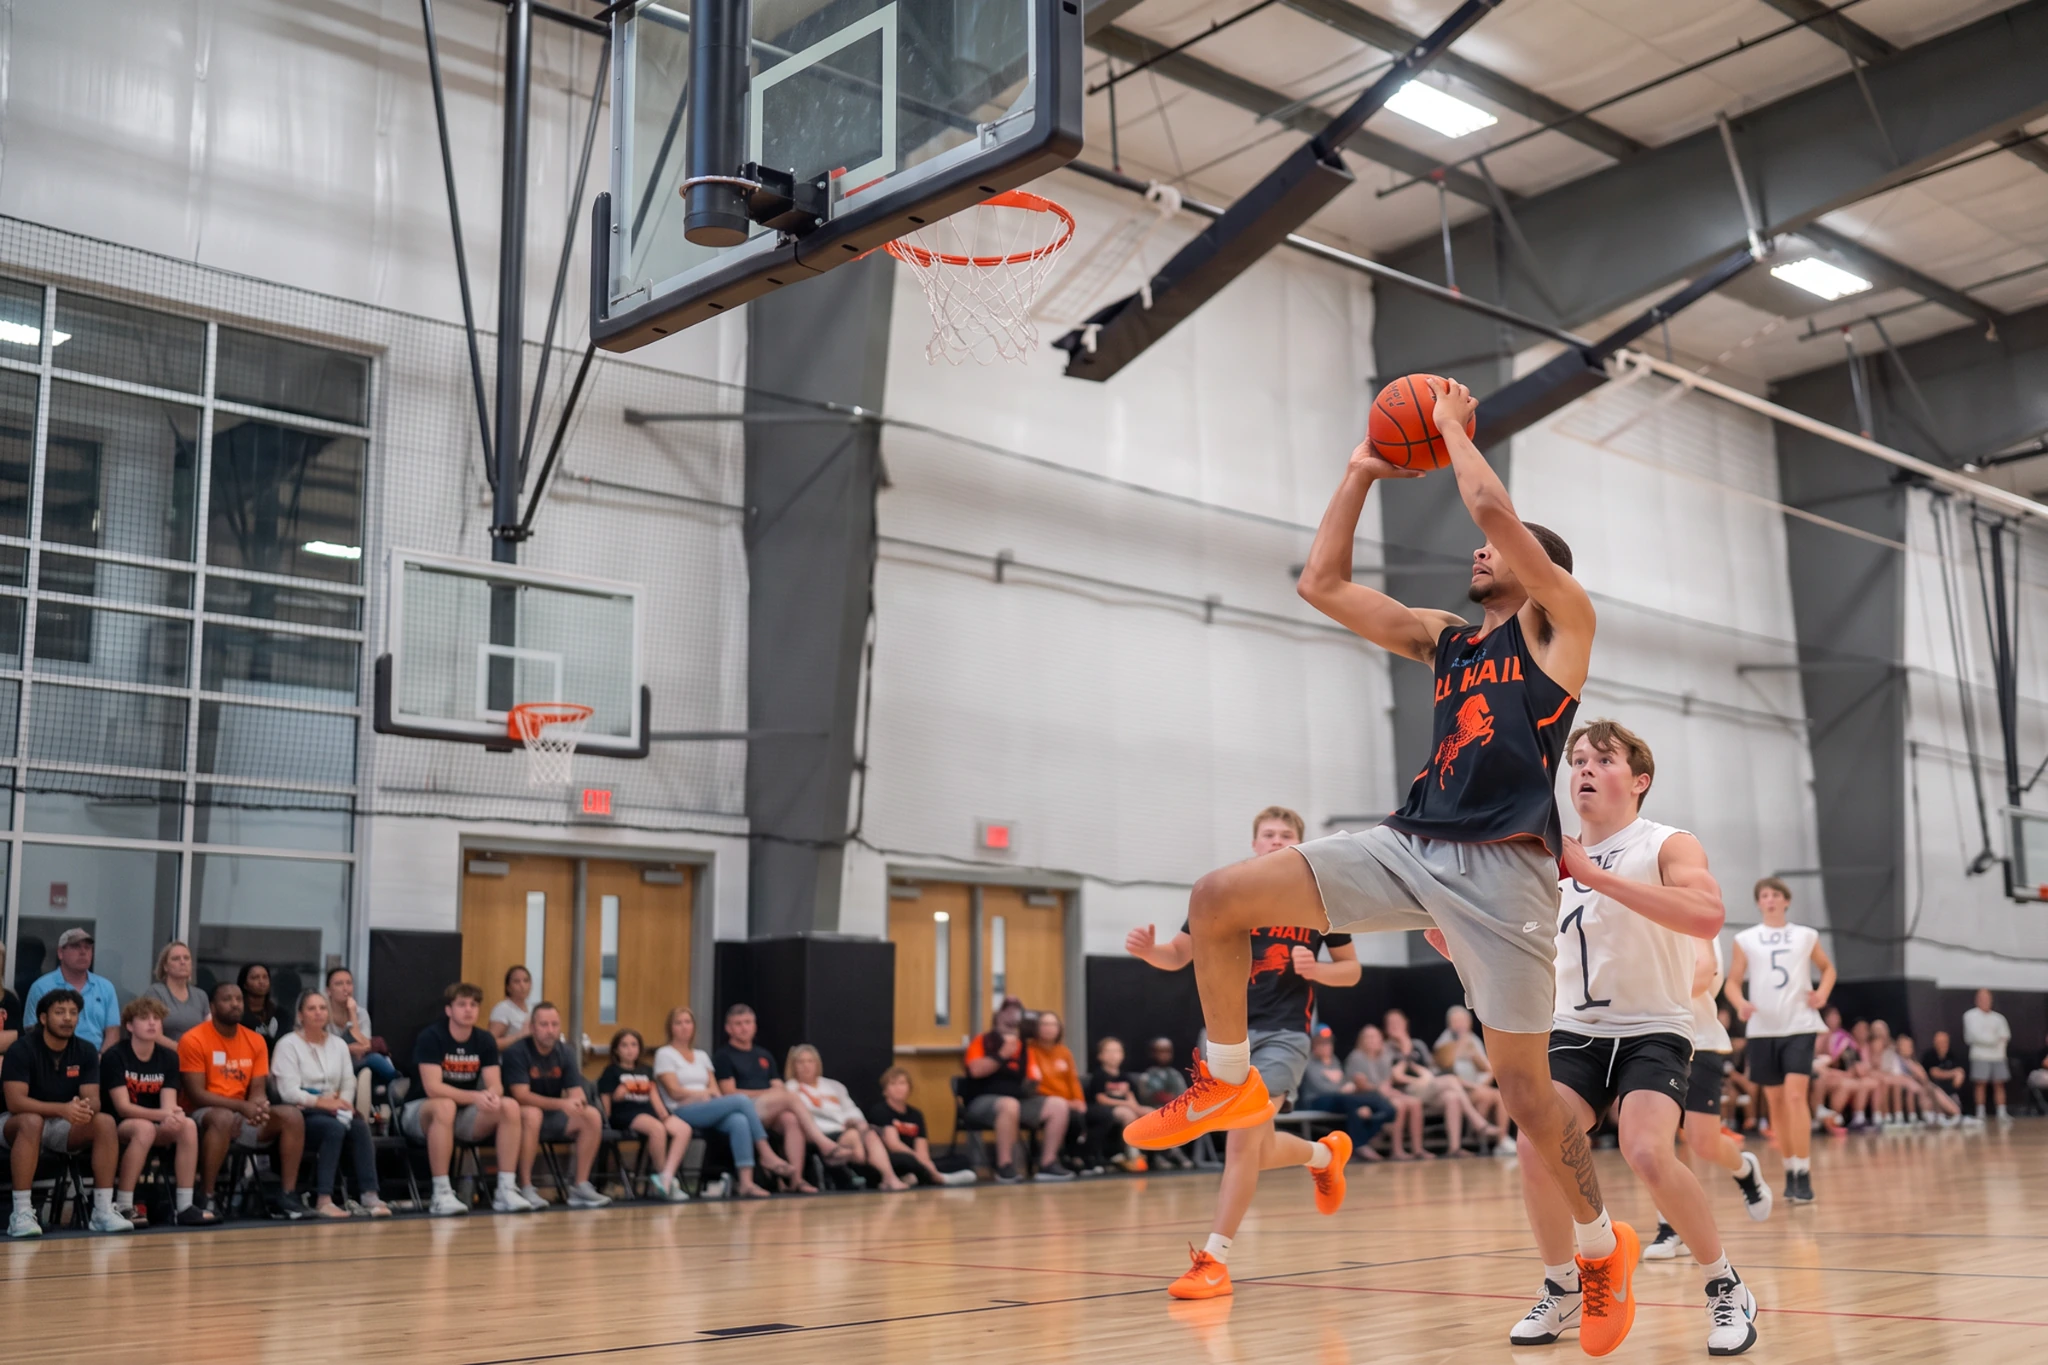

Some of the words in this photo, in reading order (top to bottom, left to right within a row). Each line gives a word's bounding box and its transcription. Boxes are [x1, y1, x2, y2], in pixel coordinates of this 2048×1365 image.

[1460, 656, 1524, 692] HAIL
[1560, 905, 1611, 1011] 1
[1771, 949, 1791, 989] 5
